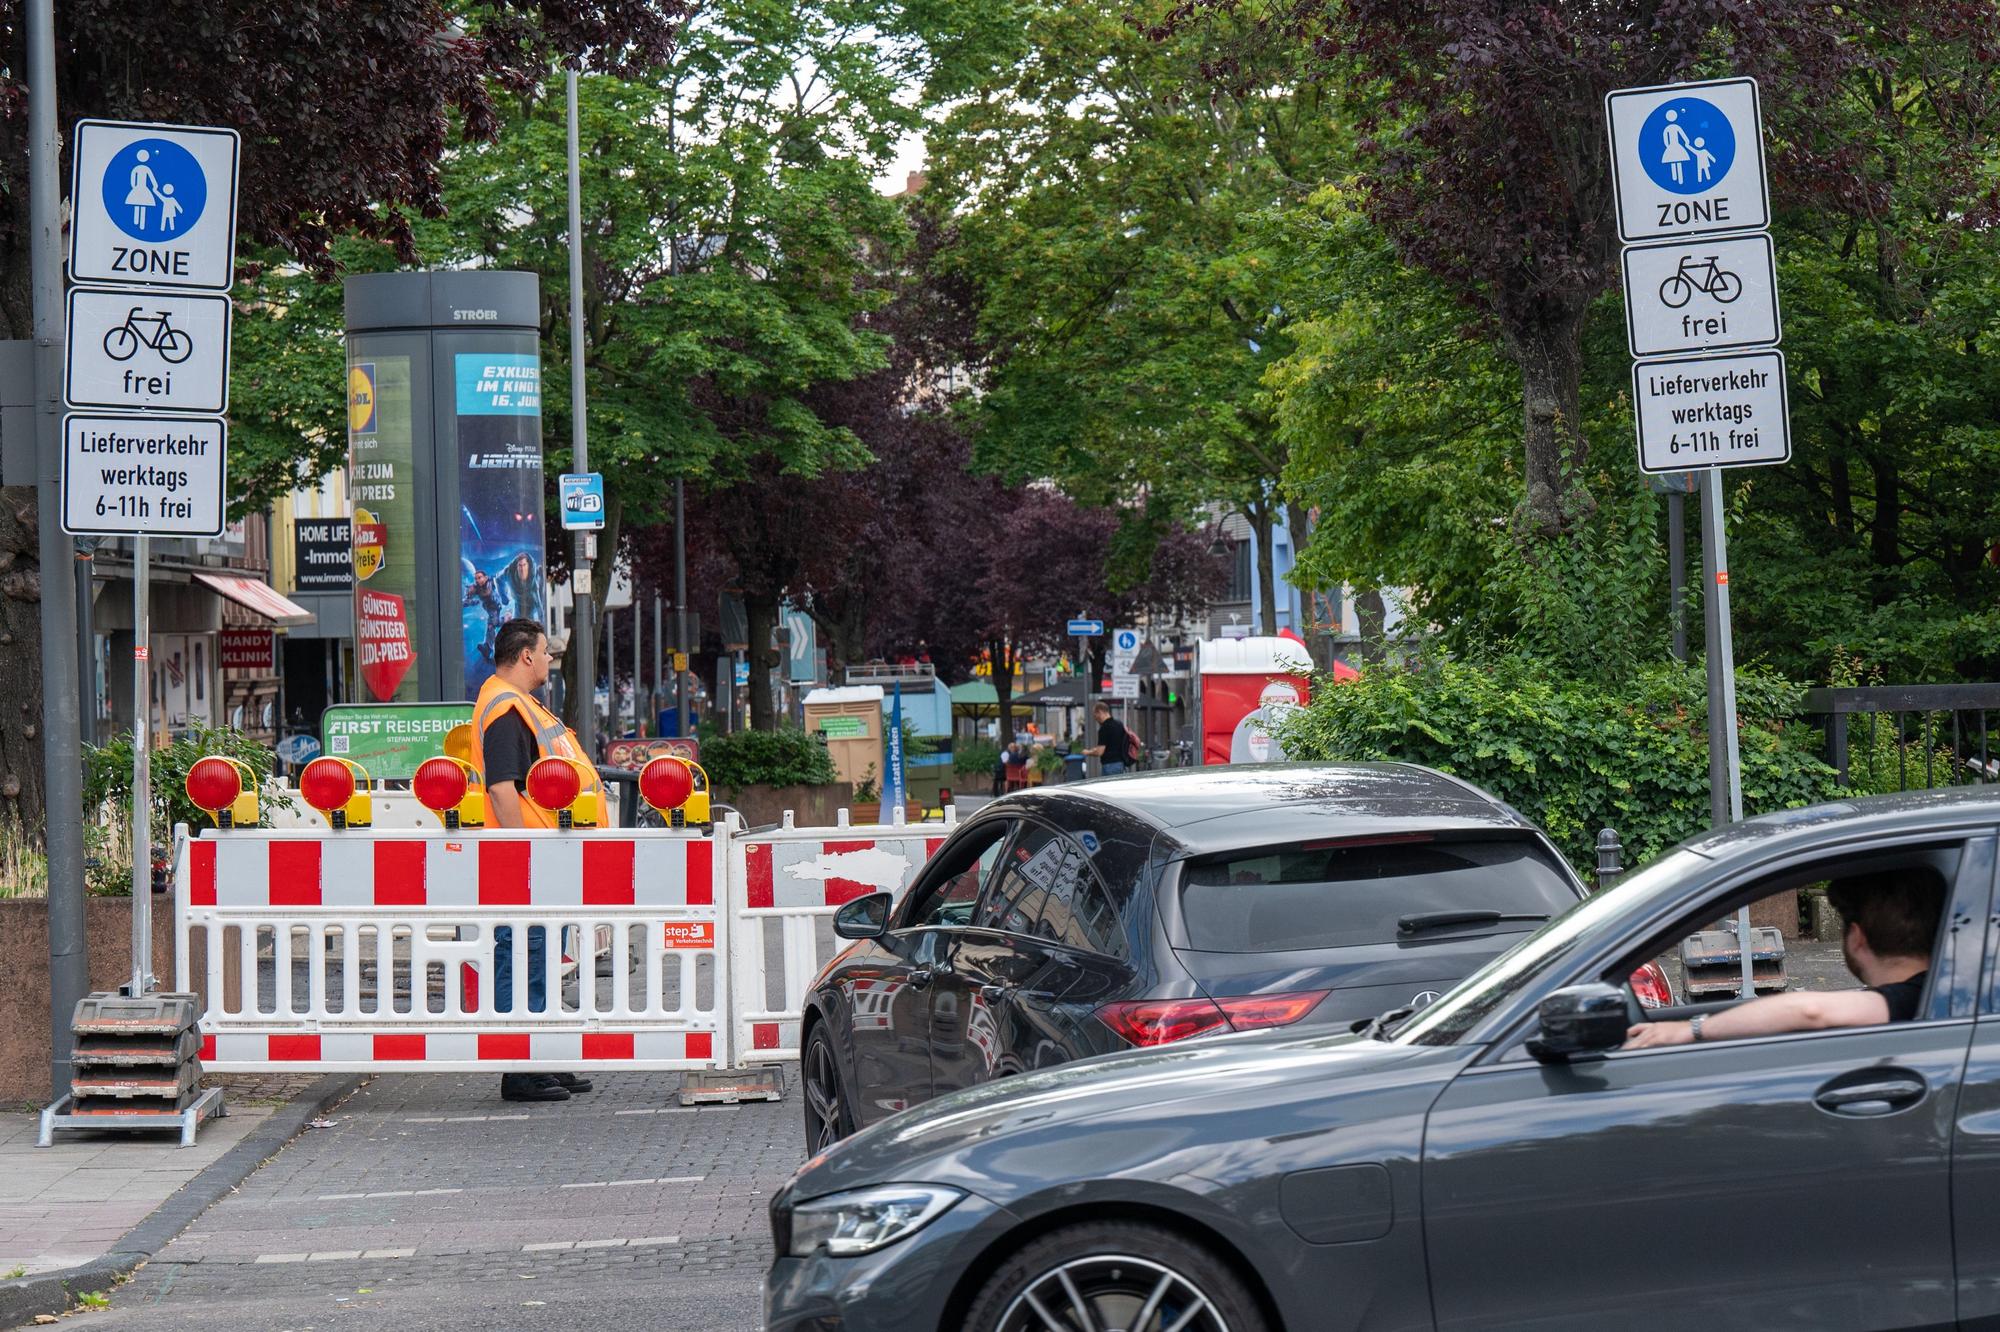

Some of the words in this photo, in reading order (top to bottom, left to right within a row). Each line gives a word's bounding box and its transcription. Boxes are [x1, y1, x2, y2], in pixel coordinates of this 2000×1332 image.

[1657, 197, 1730, 227] ZONE
[111, 246, 190, 276] ZONE
[453, 309, 497, 320] STRÖER
[1682, 311, 1727, 338] frei
[123, 369, 171, 396] frei
[476, 380, 499, 393] IM
[503, 381, 533, 393] KINO
[1650, 368, 1769, 397] Lieferverkehr
[492, 394, 514, 407] 16.
[1671, 401, 1752, 426] werktags
[80, 431, 208, 457] Lieferverkehr
[364, 438, 378, 449] sich
[1670, 432, 1720, 455] 6-11h
[1729, 427, 1759, 450] frei
[101, 465, 187, 491] werktags
[367, 463, 394, 479] ZUM
[362, 484, 395, 501] PREIS
[95, 495, 150, 518] 6-11h
[160, 496, 192, 519] frei
[300, 525, 328, 542] HOME
[331, 525, 349, 542] LIFE
[362, 594, 398, 617] GÜNSTIG
[359, 615, 406, 639] GÜNSTIGER
[222, 635, 272, 647] HANDY
[222, 652, 272, 663] KLINIK
[361, 642, 408, 666] LIDL-PREIS
[328, 721, 381, 734] FIRST
[891, 726, 901, 765] Parken
[893, 765, 901, 785] statt
[665, 927, 689, 938] step
